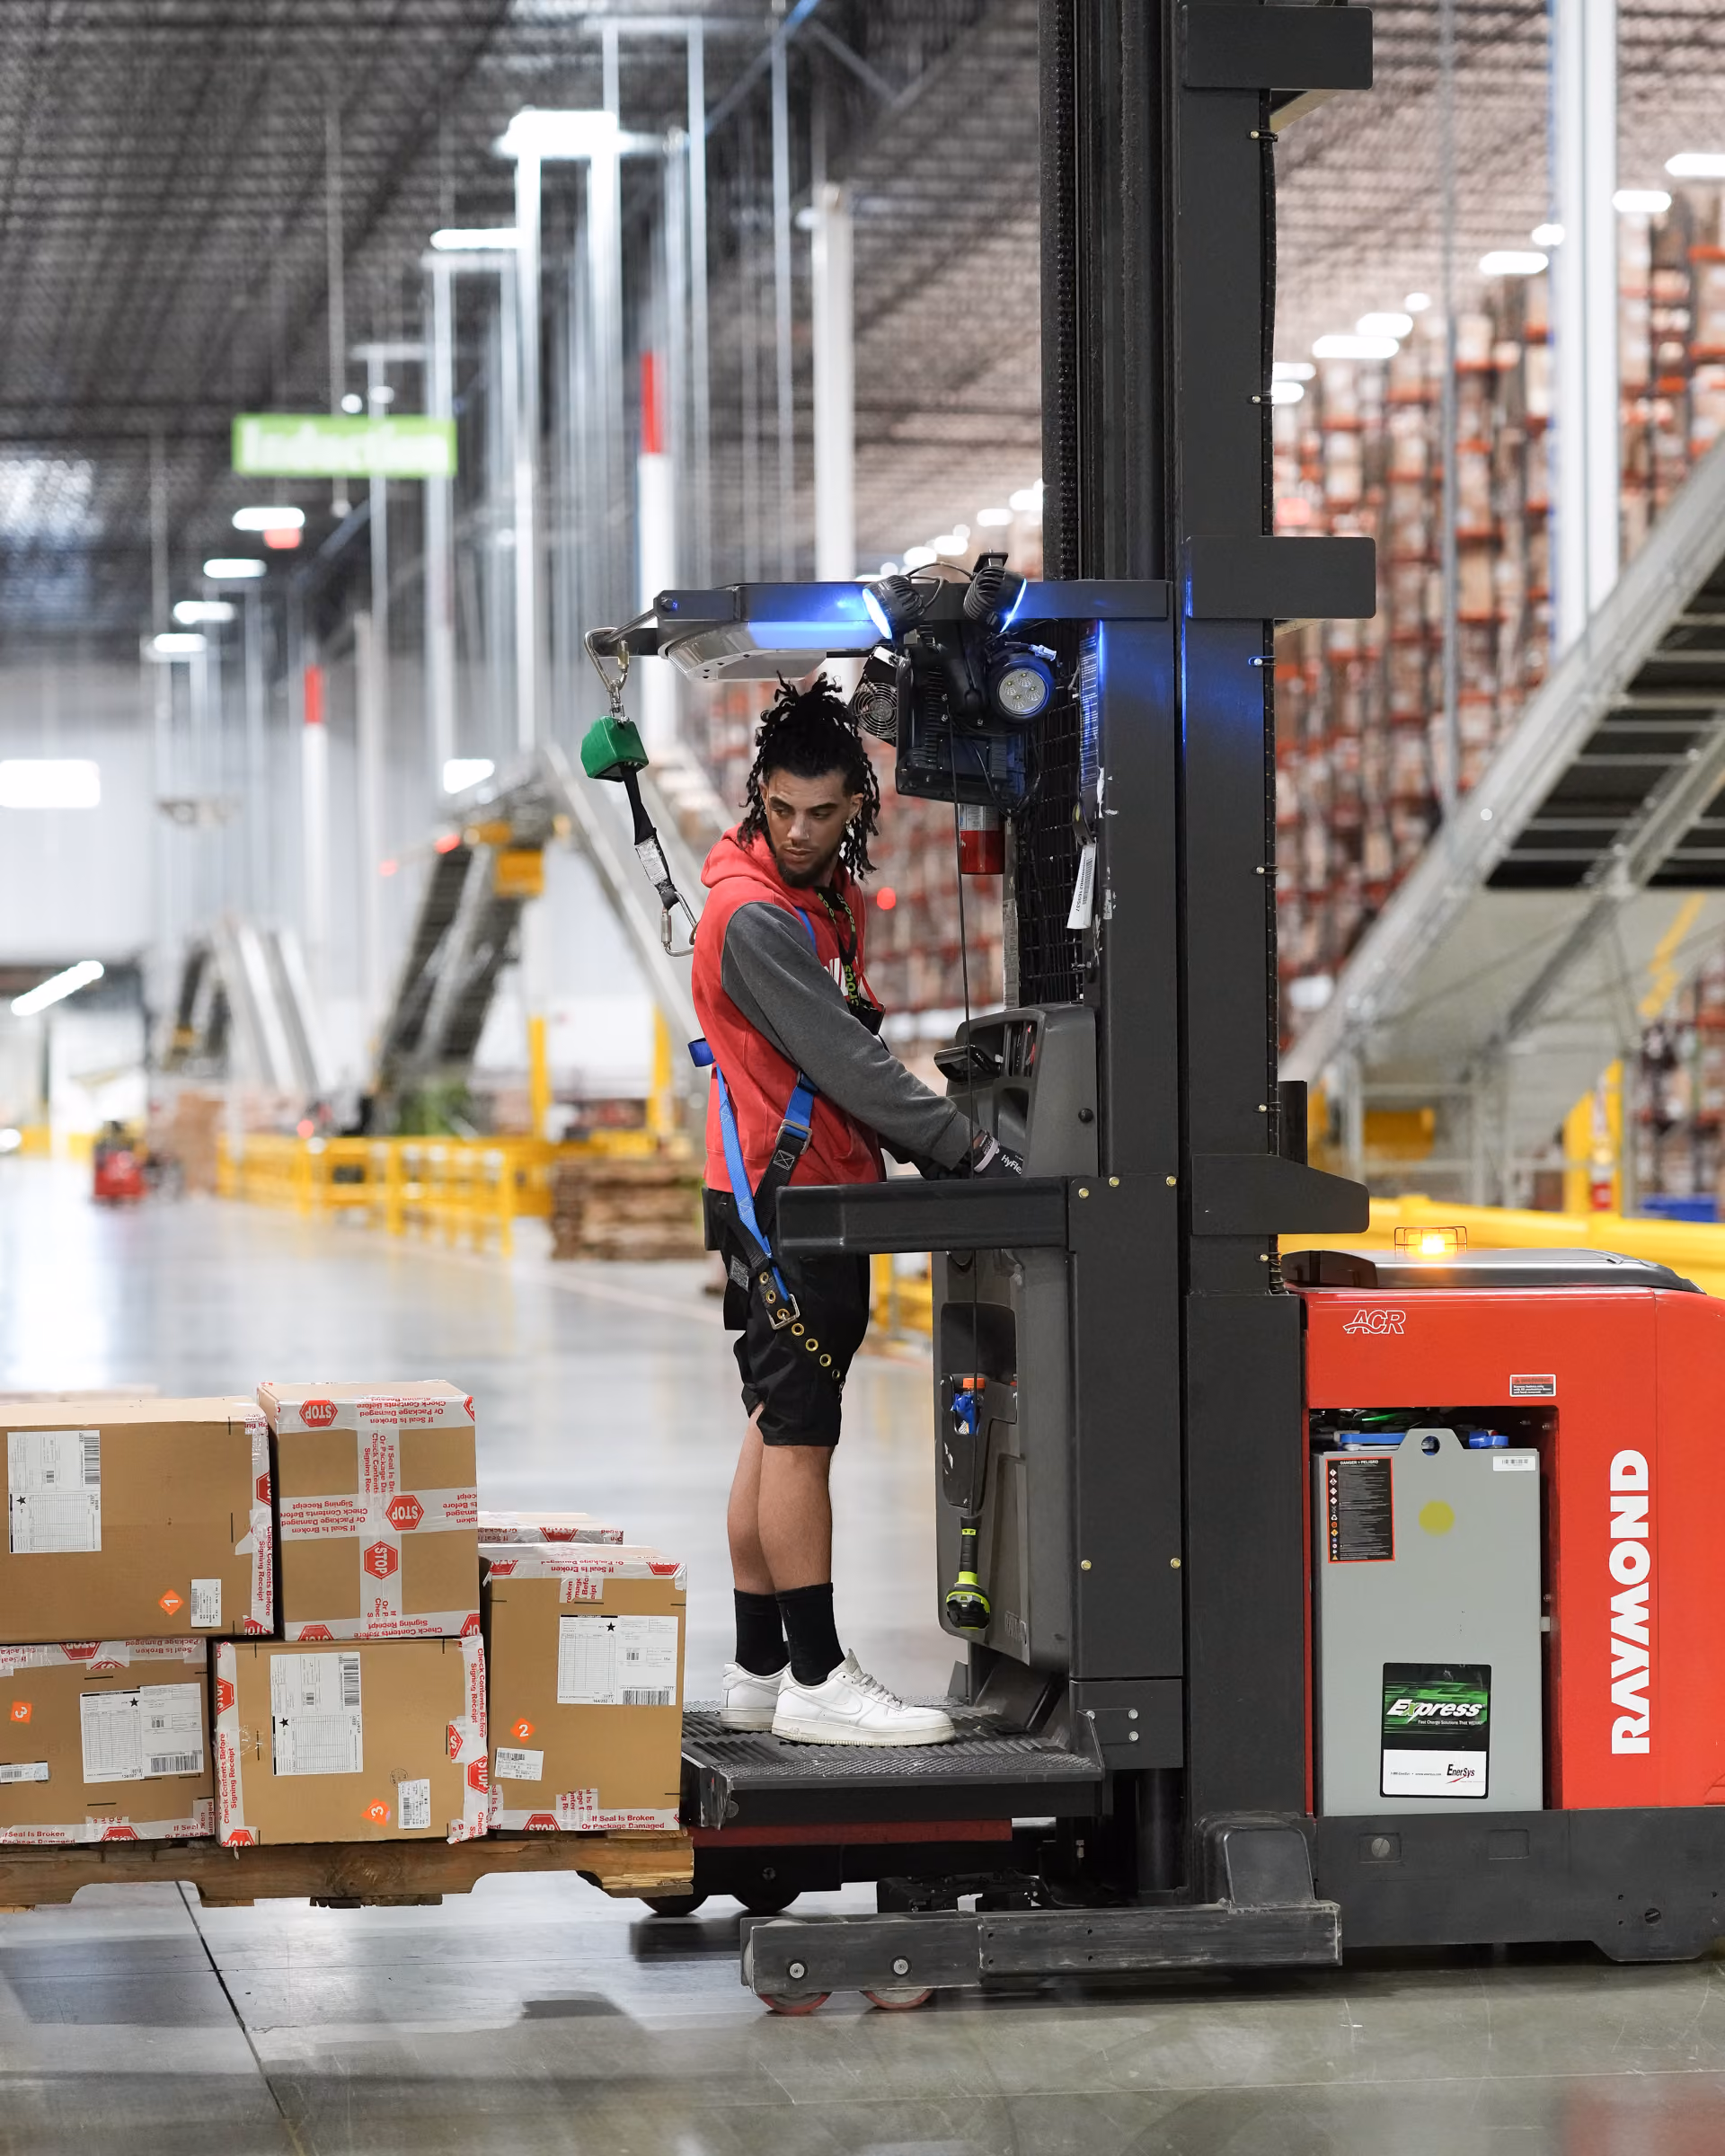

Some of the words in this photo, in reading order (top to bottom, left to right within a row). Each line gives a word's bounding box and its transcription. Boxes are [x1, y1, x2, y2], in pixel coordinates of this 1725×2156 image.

[817, 893, 836, 925] rocs
[836, 893, 855, 932] crocs
[844, 965, 859, 1006] crocs
[1001, 1154, 1022, 1174] HyFle
[1343, 1310, 1406, 1334] ACR
[305, 1404, 332, 1420] STOP
[380, 1436, 385, 1445] Or
[306, 1509, 341, 1517] Contents
[392, 1506, 419, 1520] STOP
[374, 1547, 387, 1574] STOP
[164, 1599, 179, 1607] 1
[383, 1601, 388, 1610] Or
[1609, 1449, 1651, 1754] RAYMOND
[382, 1629, 416, 1637] Contents
[14, 1705, 29, 1719] 3
[1386, 1699, 1482, 1724] Express
[518, 1724, 529, 1738] 2
[219, 1733, 227, 1760] Before
[227, 1748, 235, 1778] Receipt
[1446, 1764, 1475, 1778] EnerSys
[370, 1806, 385, 1819] 3
